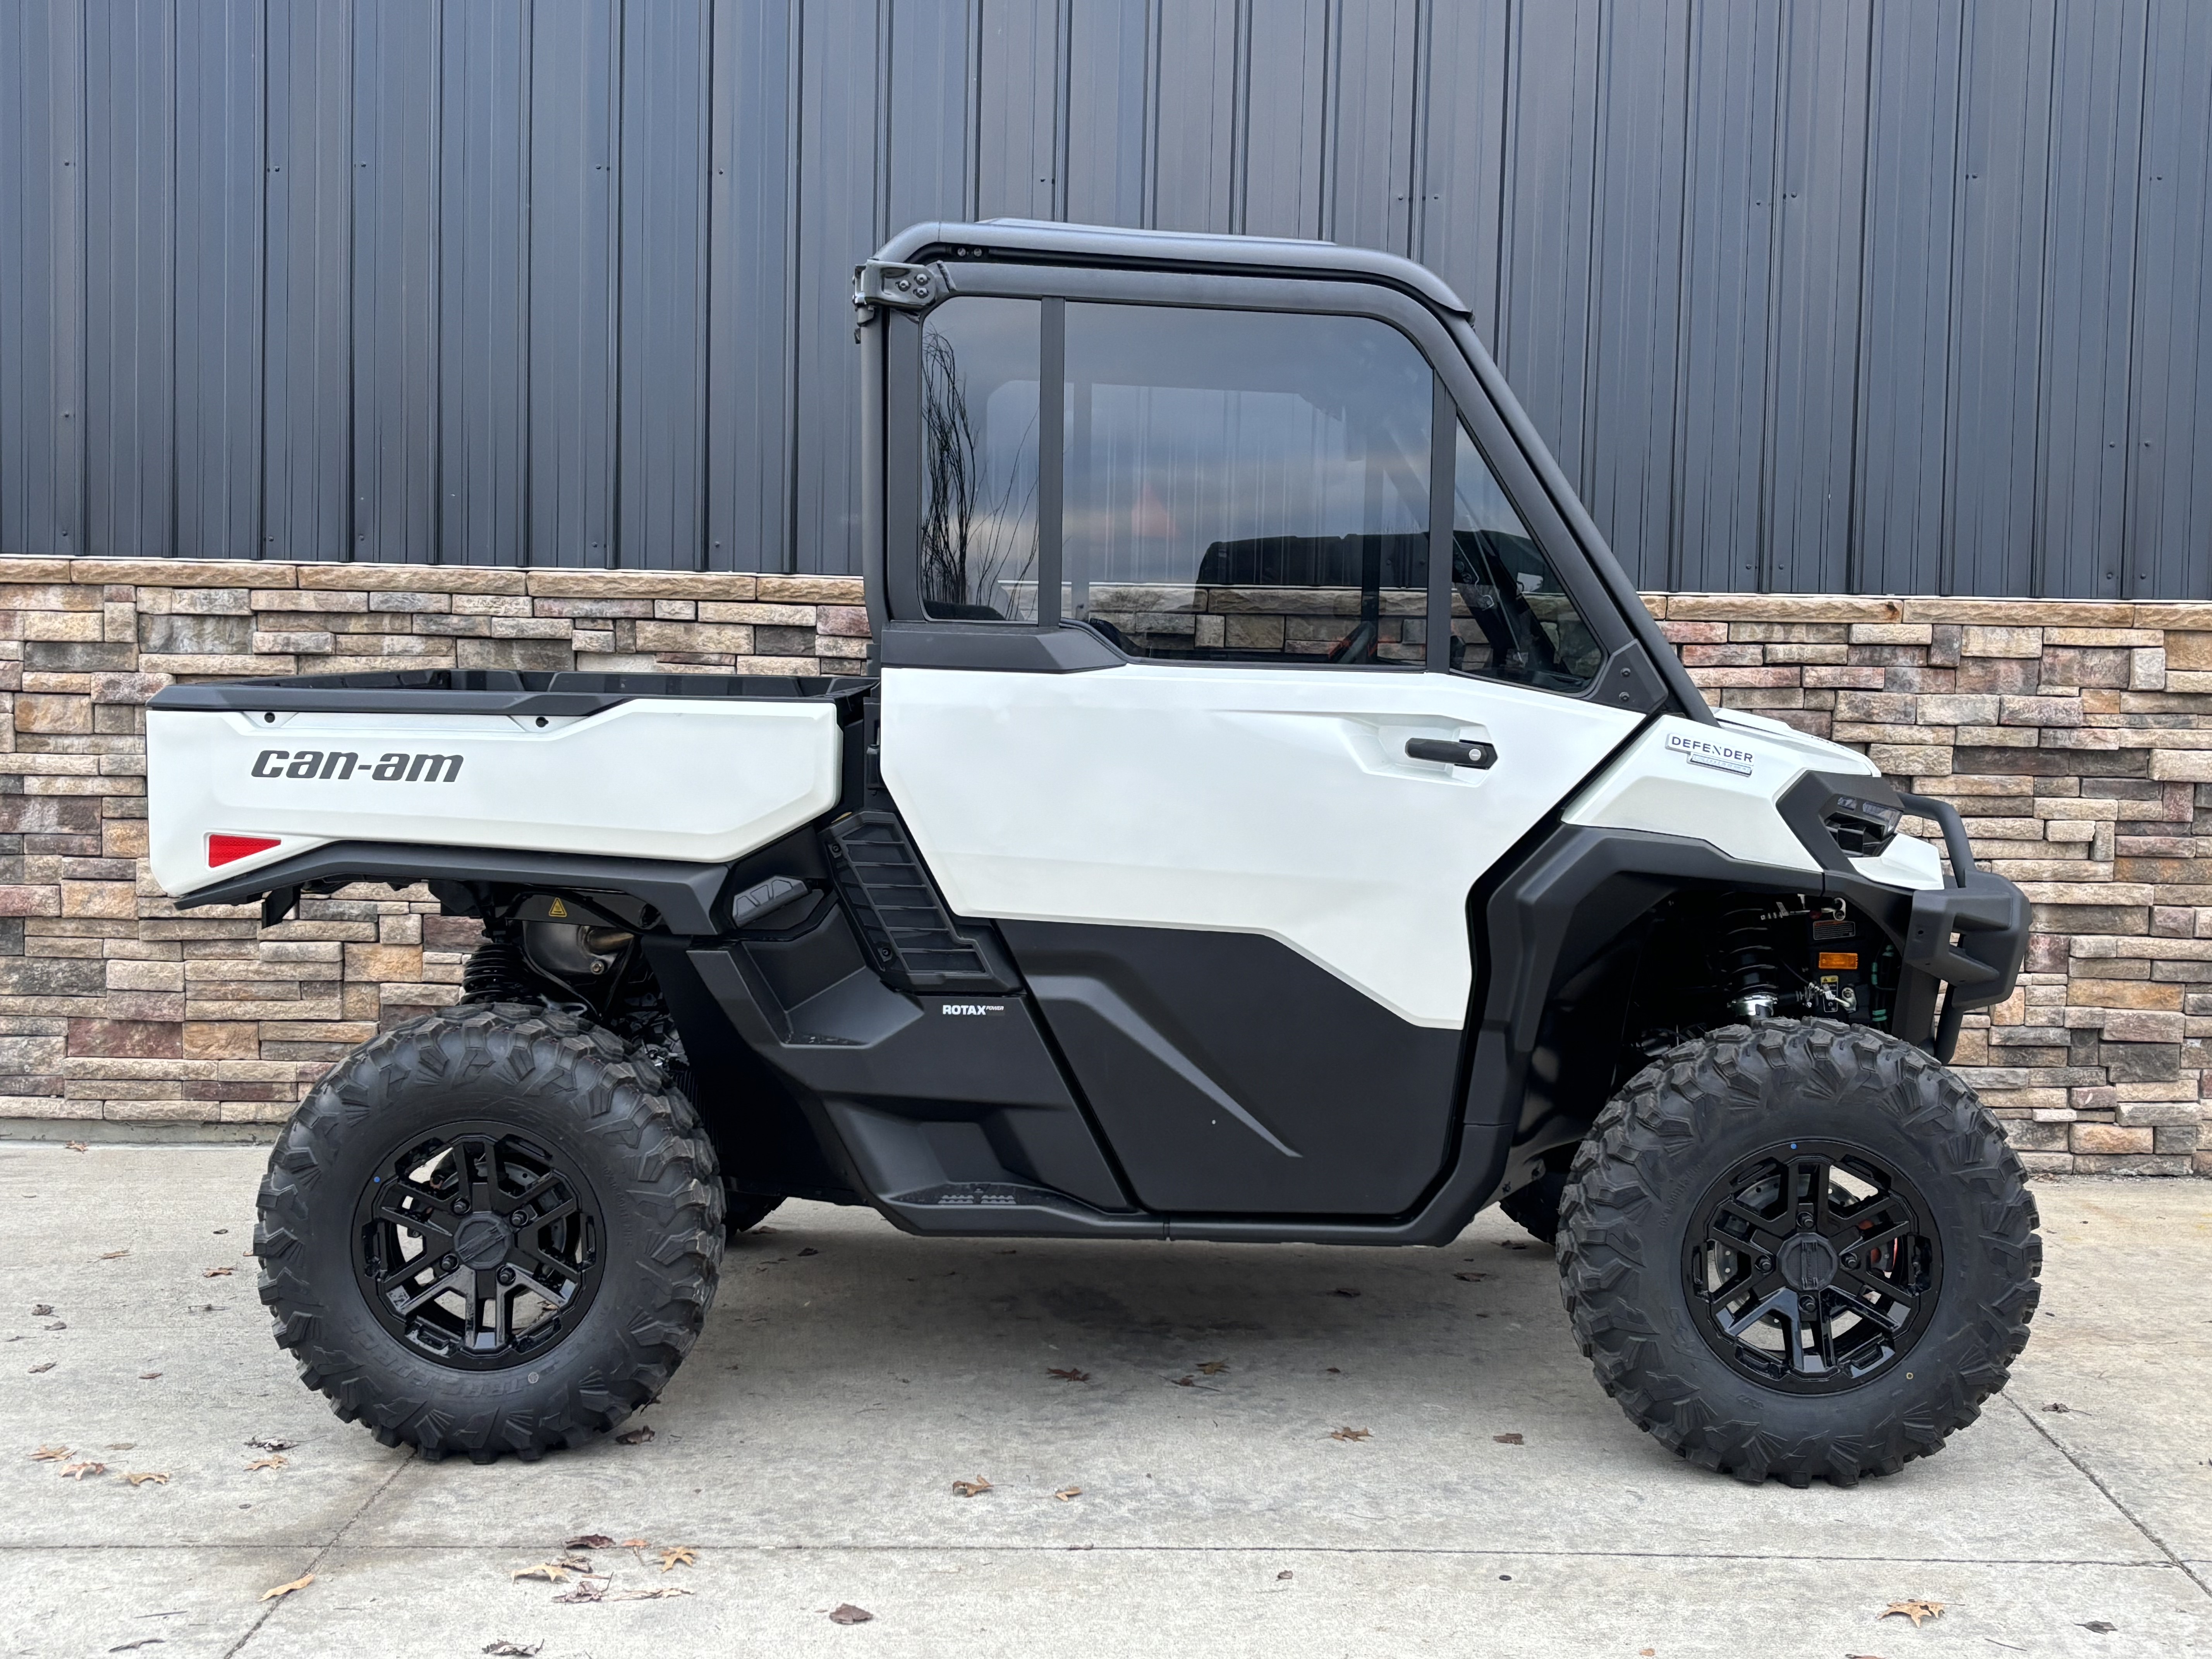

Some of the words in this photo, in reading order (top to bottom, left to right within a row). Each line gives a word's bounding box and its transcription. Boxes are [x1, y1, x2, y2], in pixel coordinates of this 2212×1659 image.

[1672, 737, 1753, 763] DEFENDER
[251, 750, 464, 782] can-am
[943, 1005, 986, 1015] ROTAX
